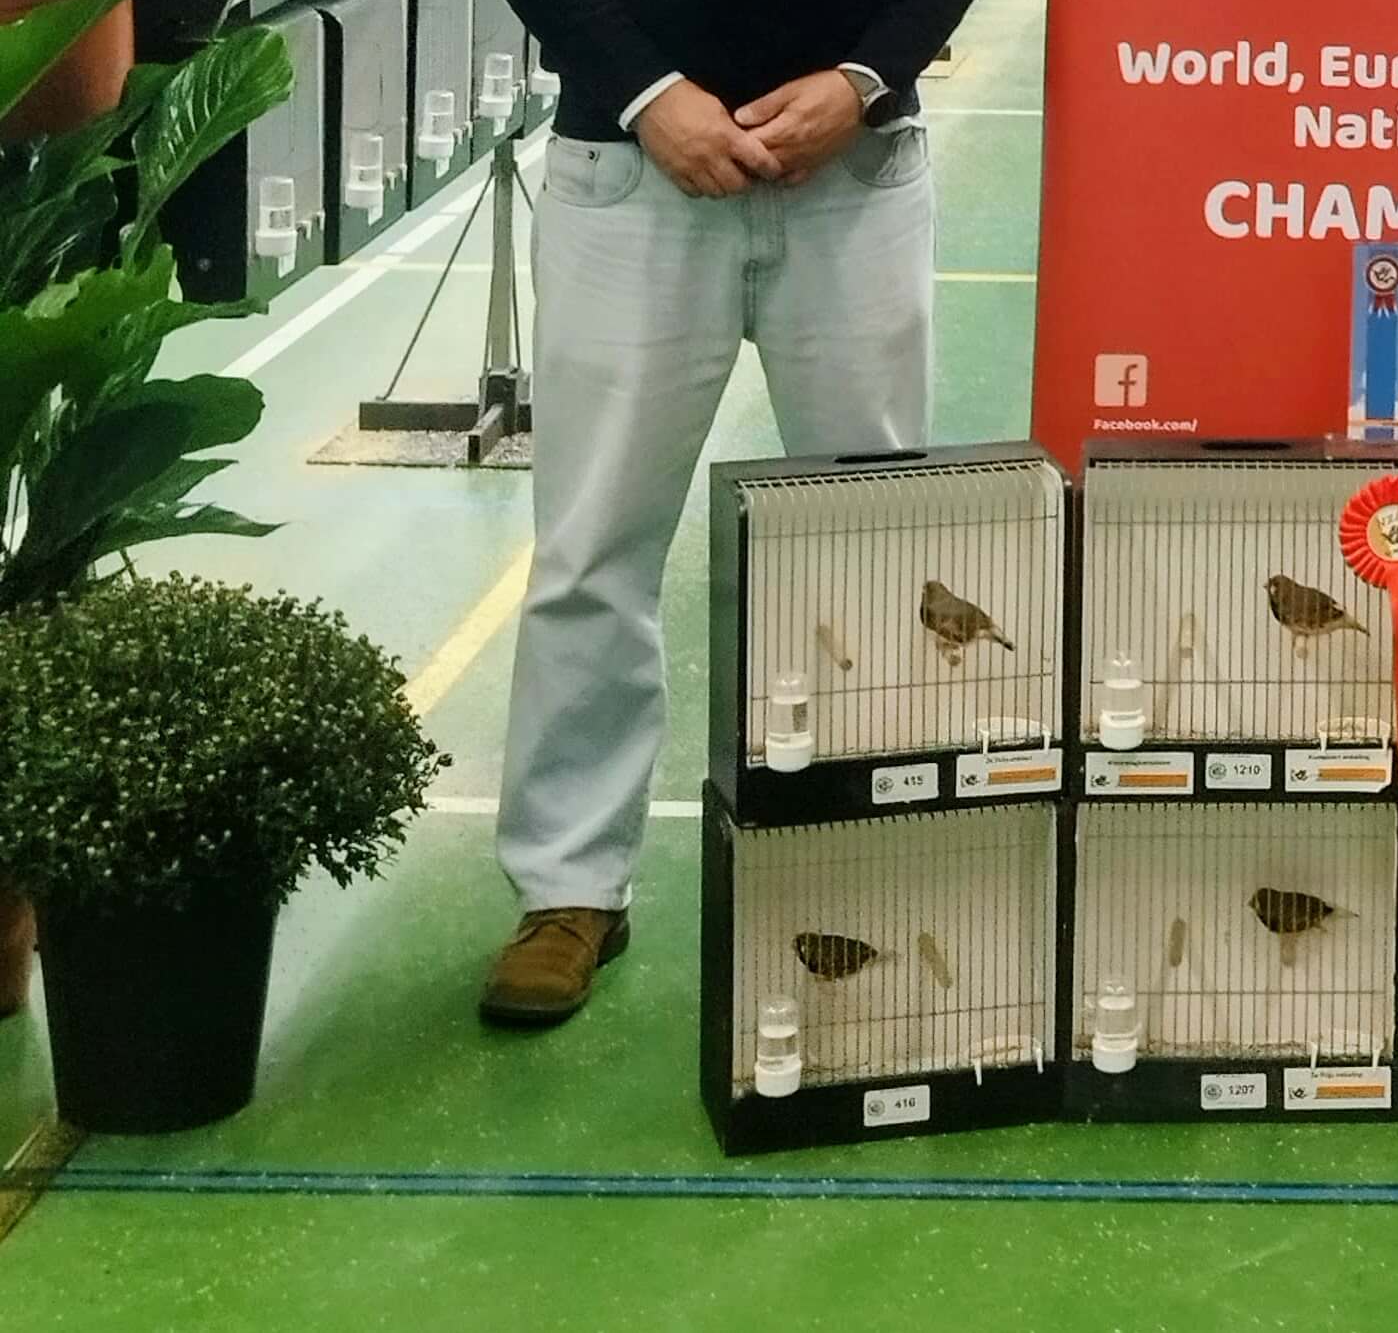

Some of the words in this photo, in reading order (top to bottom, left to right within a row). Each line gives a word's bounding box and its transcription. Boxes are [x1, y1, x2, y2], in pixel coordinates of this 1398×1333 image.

[1117, 40, 1305, 94] World,
[1093, 418, 1198, 433] Facebook.com/
[1233, 764, 1261, 776] 1210
